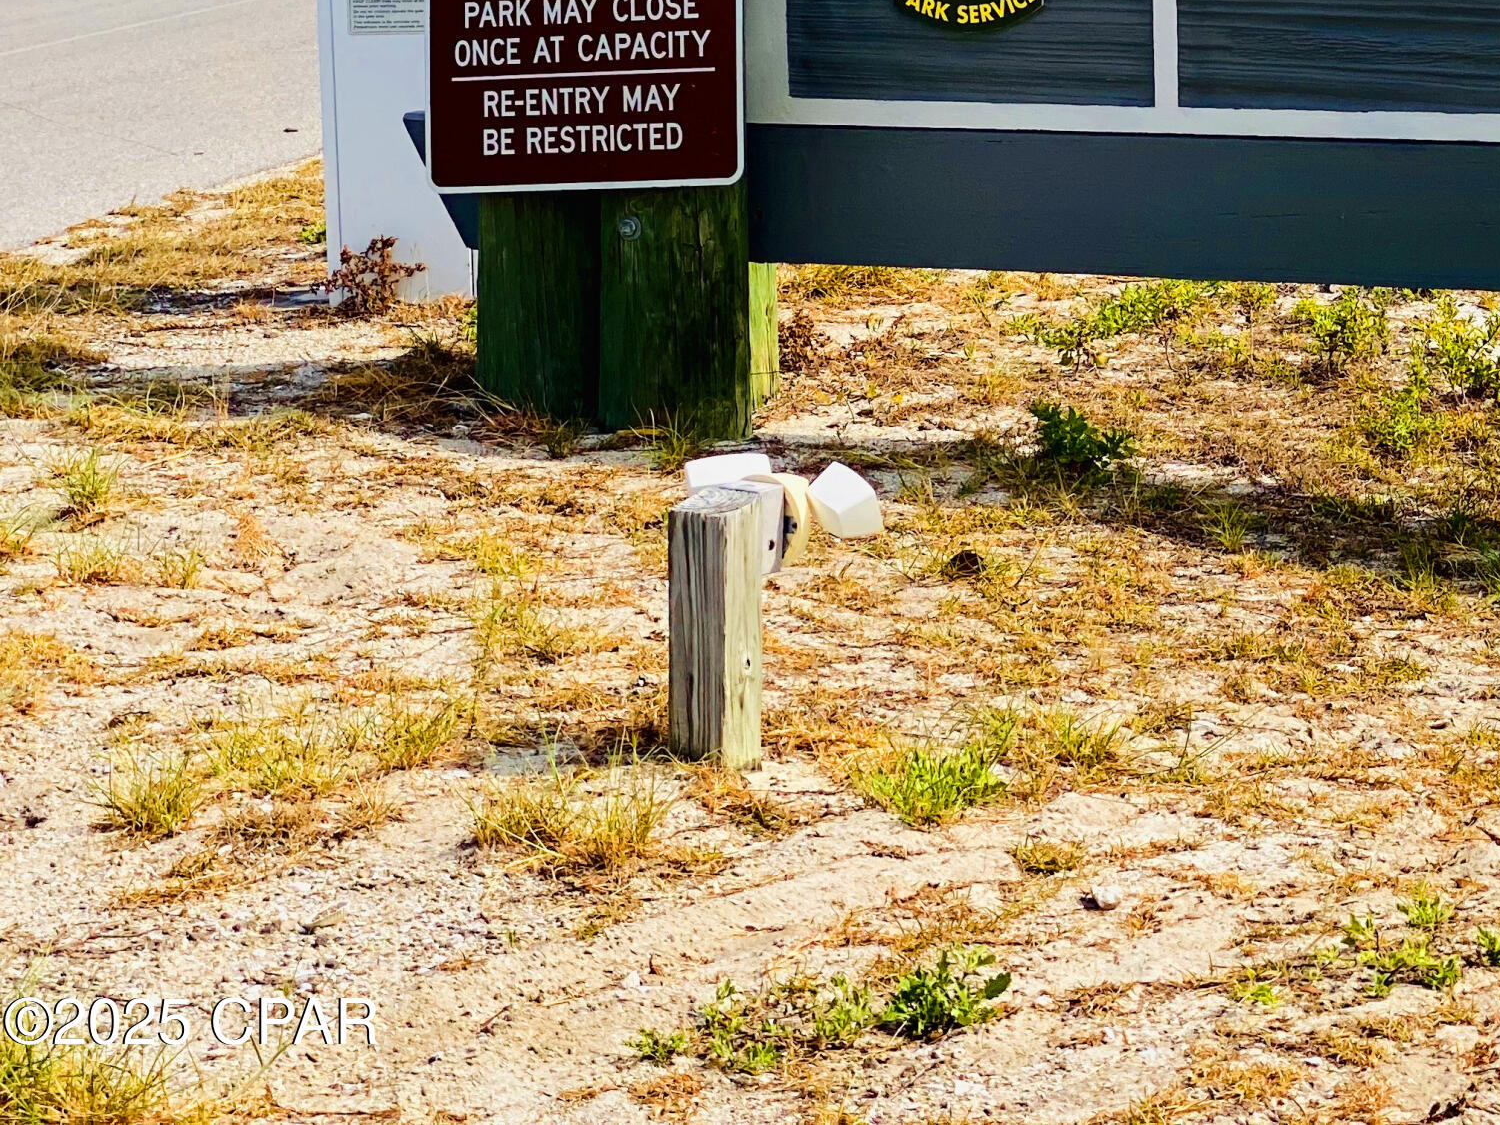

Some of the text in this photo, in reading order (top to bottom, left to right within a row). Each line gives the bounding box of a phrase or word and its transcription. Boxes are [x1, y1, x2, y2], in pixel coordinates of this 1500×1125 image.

[454, 29, 711, 67] ONCE AT CAPACITY
[483, 83, 681, 118] RE-ENTRY MAY
[483, 122, 683, 156] BE RESTRICTED
